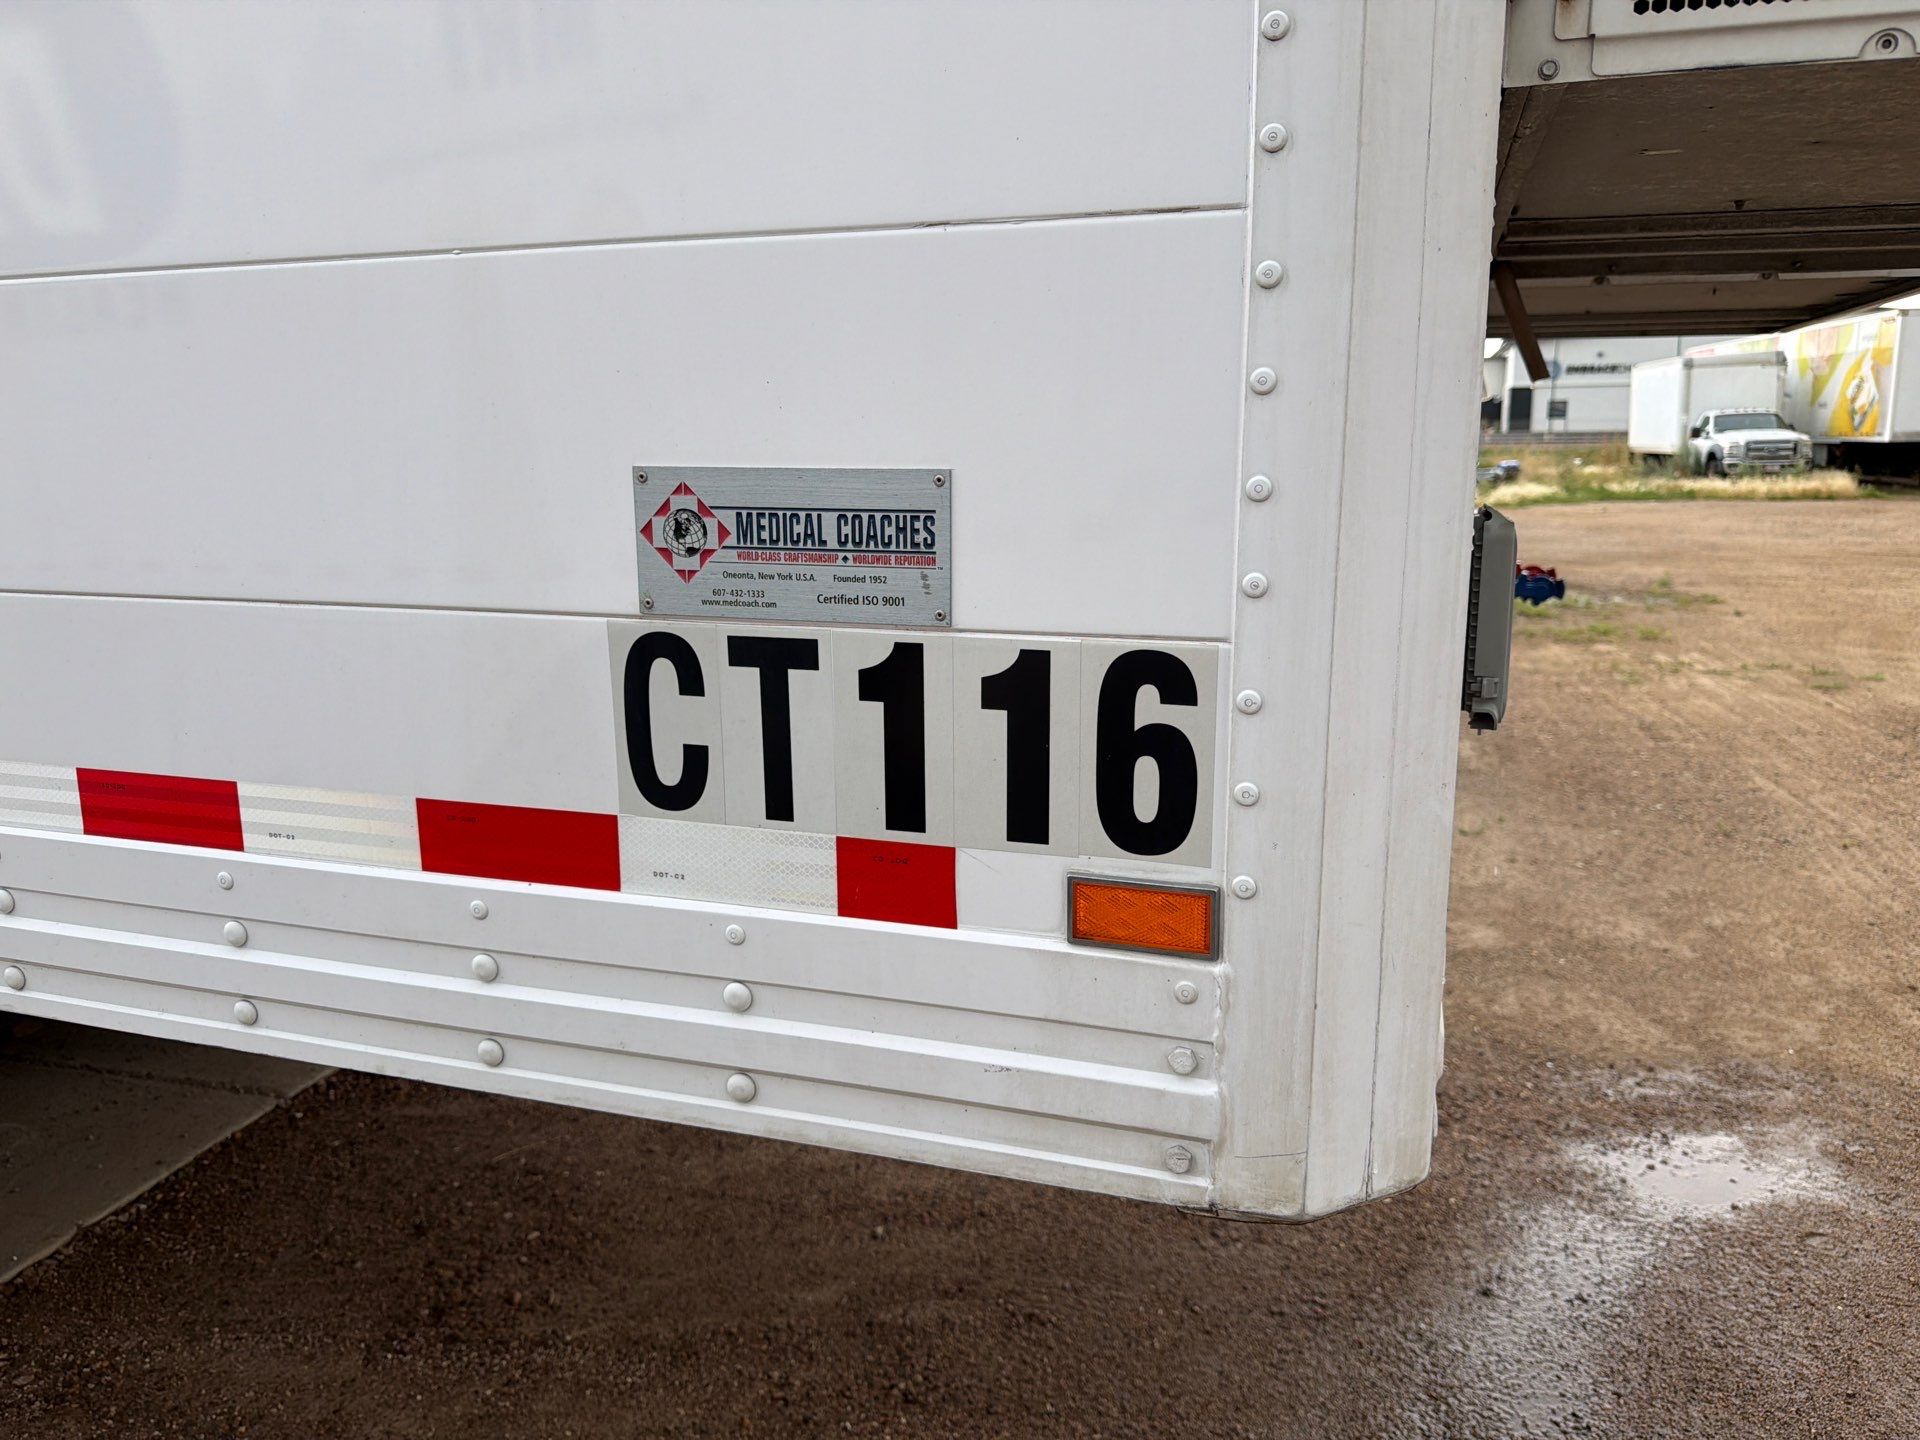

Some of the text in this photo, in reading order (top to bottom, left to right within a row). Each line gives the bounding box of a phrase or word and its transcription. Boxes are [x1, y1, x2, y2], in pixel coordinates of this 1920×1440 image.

[735, 511, 936, 550] MEDICAL COACHES
[736, 551, 936, 567] WORLD-CLASS CRAFTSMANSHIP WORLDWIDE REPUTATION
[722, 570, 817, 582] Oneonta, New York U.S.A.
[833, 574, 888, 584] Founded 1952
[712, 588, 765, 598] 607-432-1333
[701, 598, 777, 609] www.medcoach.com
[817, 593, 905, 607] Certified ISO 9001
[624, 631, 1198, 856] CT116
[653, 871, 685, 880] DOT-C2
